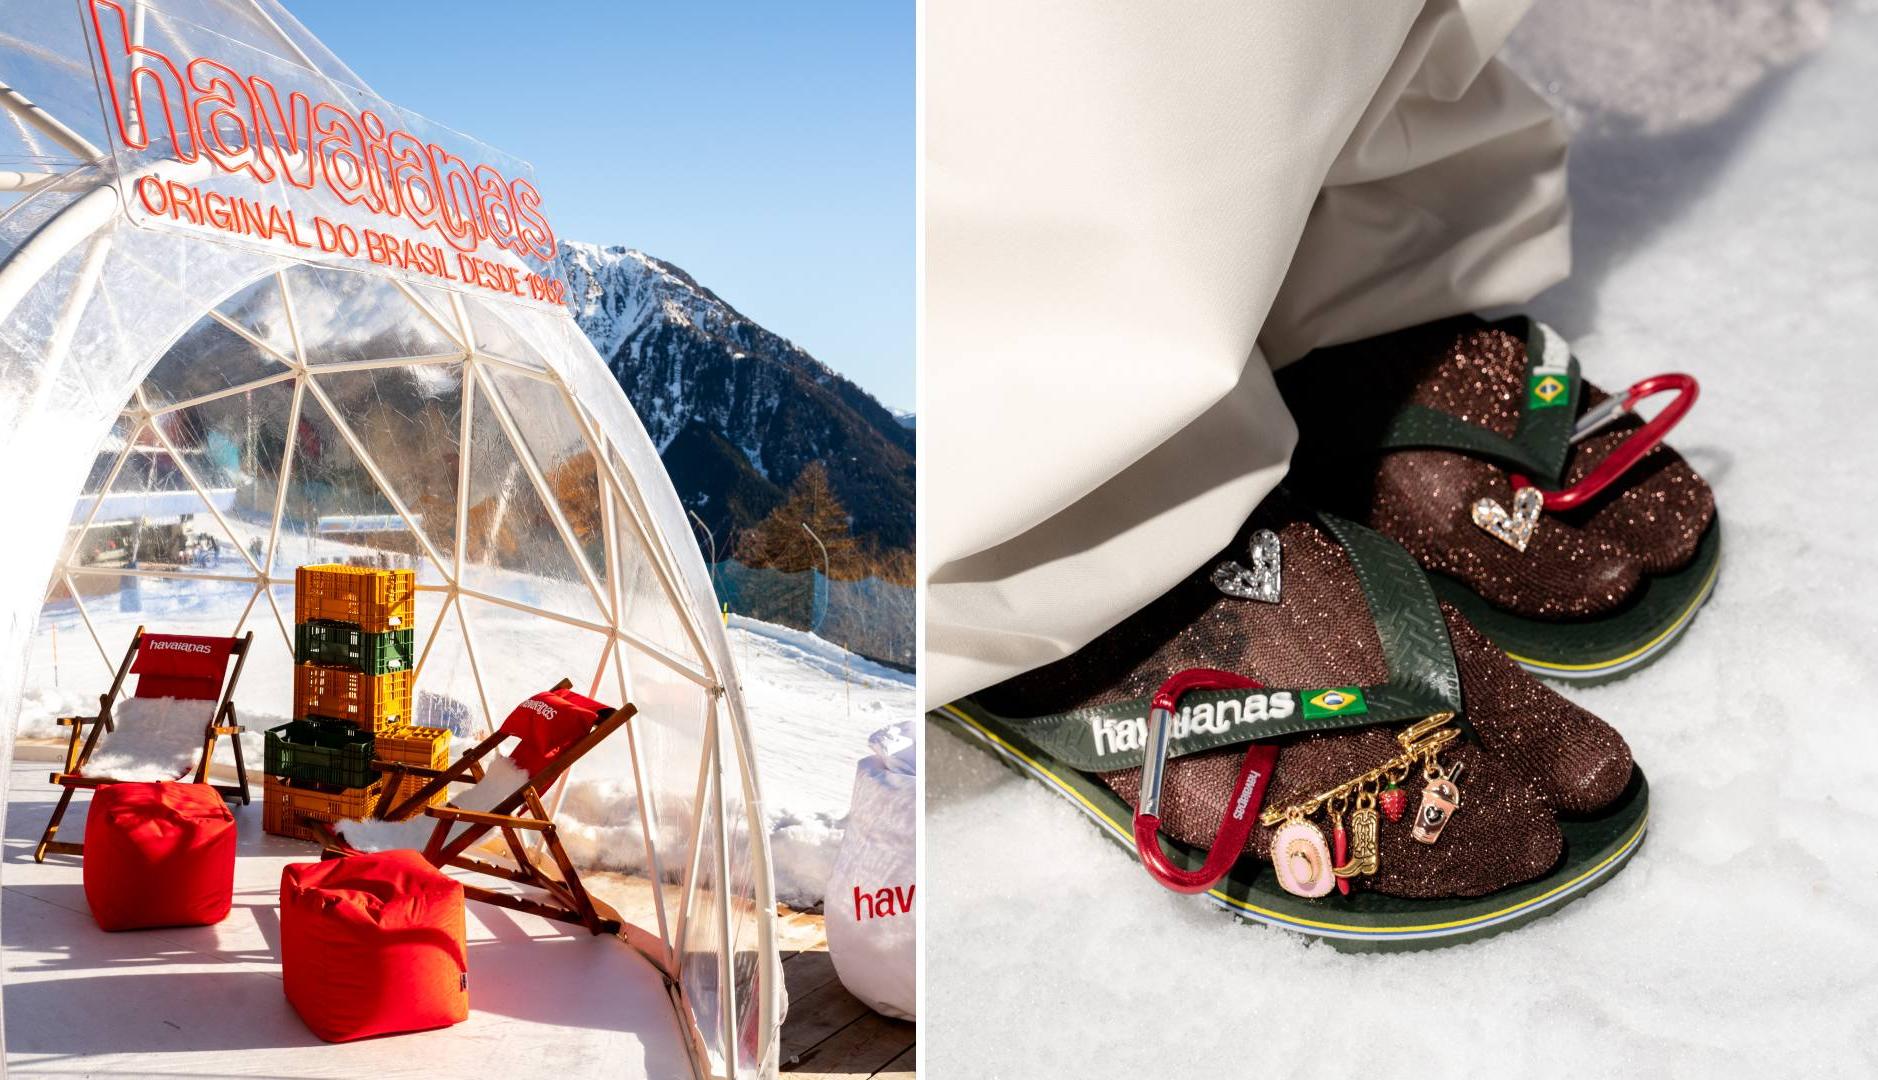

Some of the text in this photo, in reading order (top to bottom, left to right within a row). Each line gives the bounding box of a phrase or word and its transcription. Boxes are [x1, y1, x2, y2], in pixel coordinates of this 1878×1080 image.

[90, 0, 556, 262] havaianas
[139, 175, 566, 305] ORIGINAL DO BRASIL DESDE 1962
[149, 639, 212, 655] havaianas
[853, 884, 916, 921] hav
